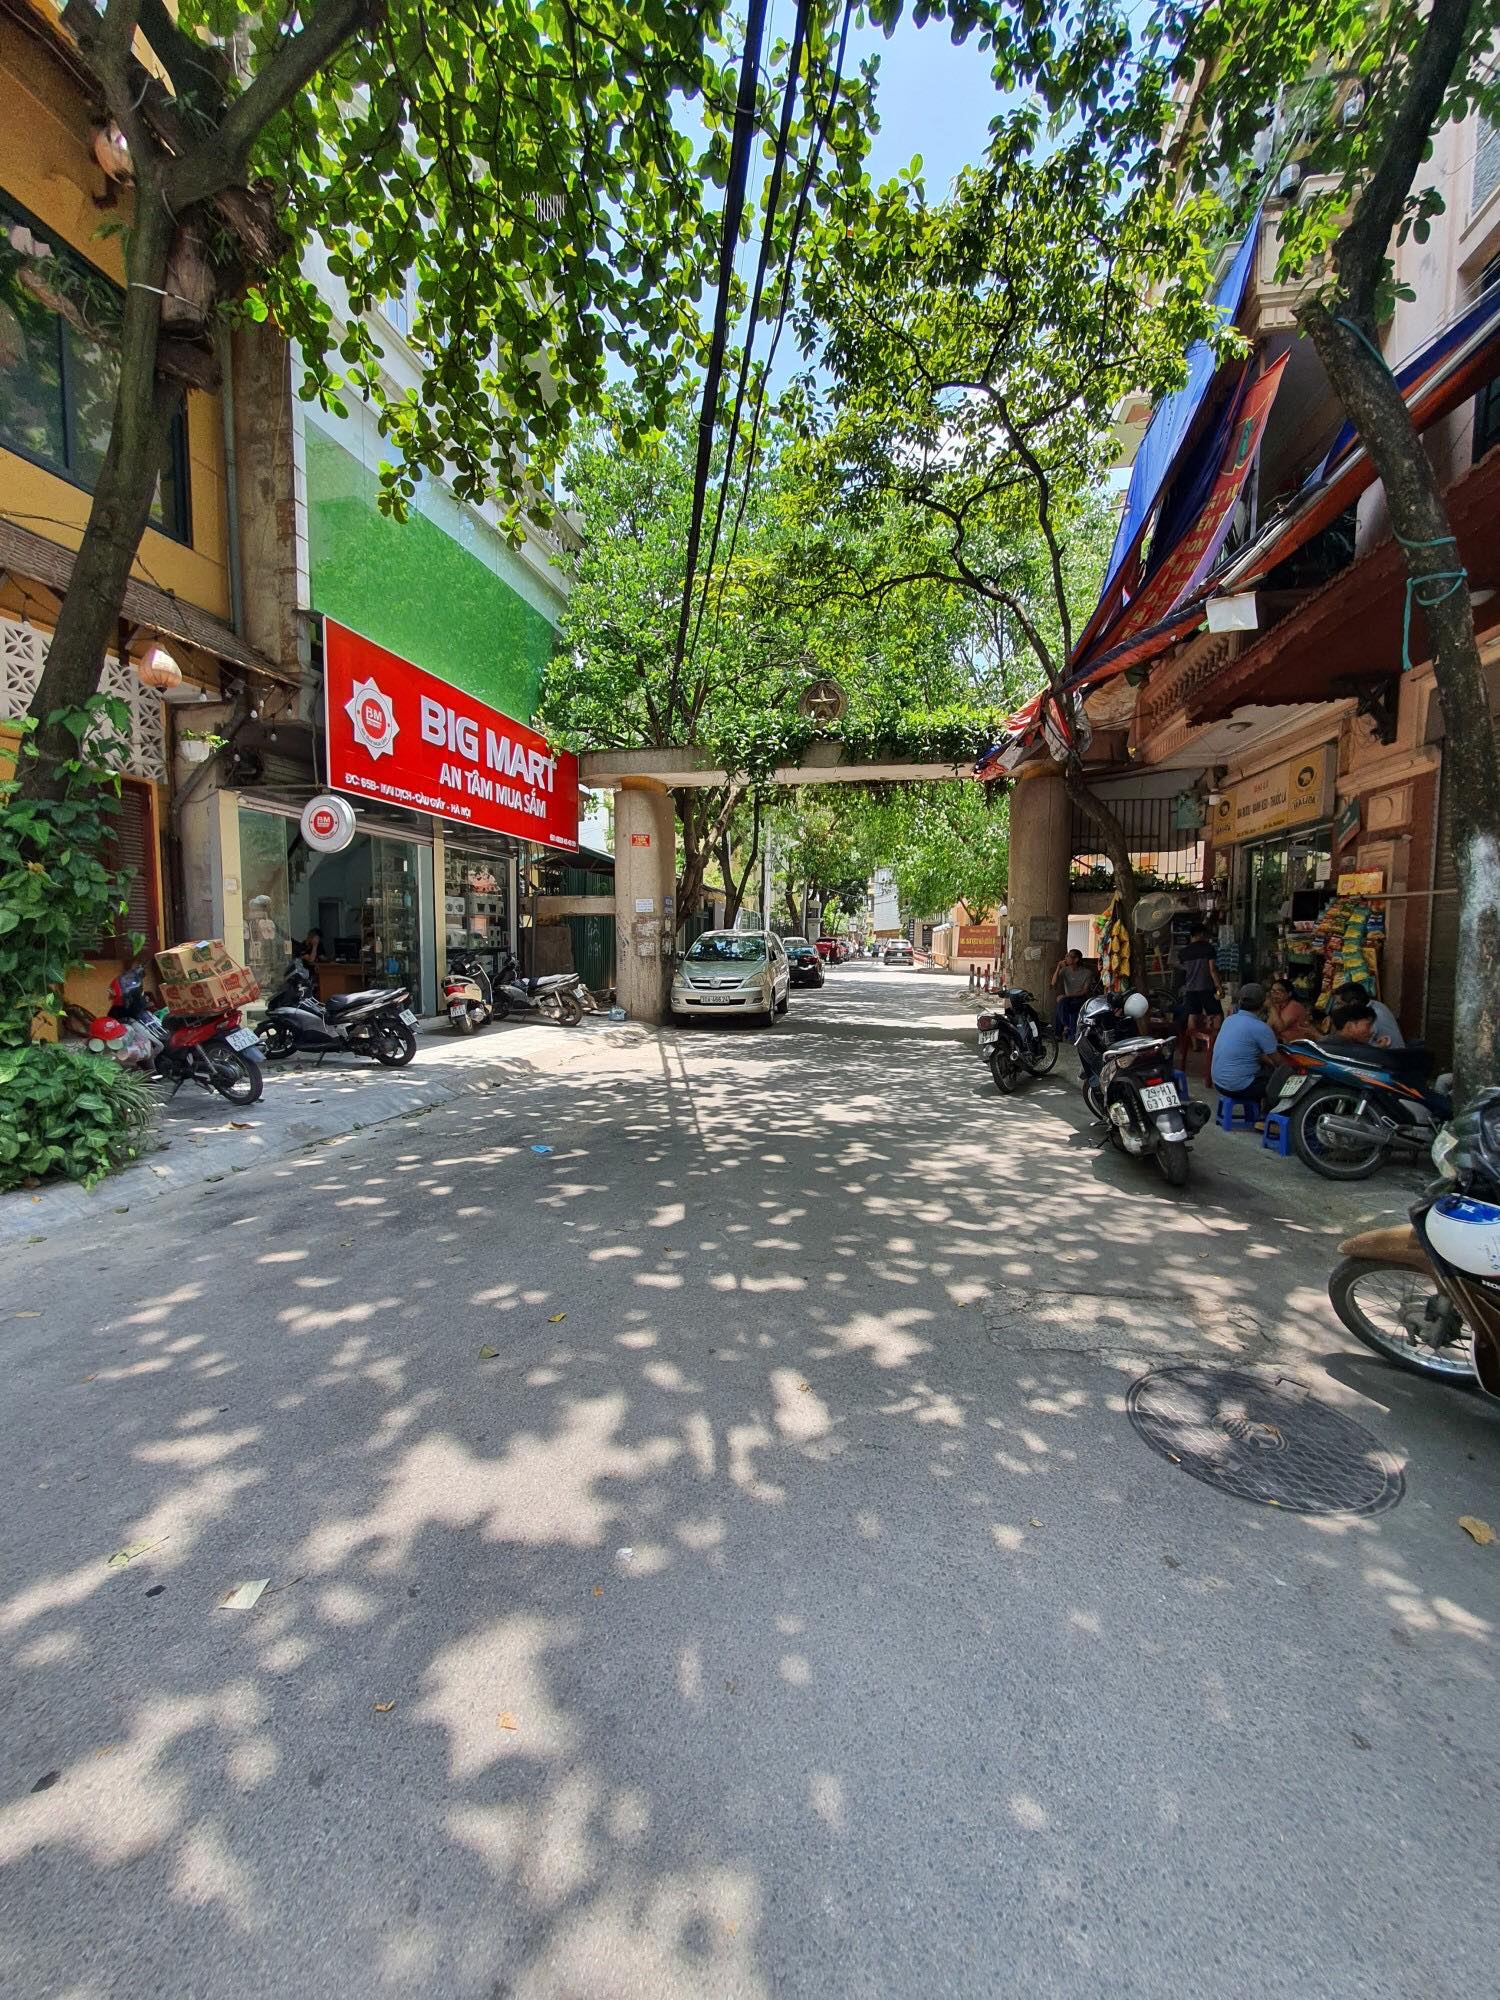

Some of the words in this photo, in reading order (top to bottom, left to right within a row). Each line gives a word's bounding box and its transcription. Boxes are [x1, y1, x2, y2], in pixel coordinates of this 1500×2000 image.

[366, 706, 382, 722] BM
[420, 694, 479, 762] BIG
[486, 727, 557, 793] MART
[439, 762, 462, 791] AN
[464, 769, 494, 801] TÂM
[495, 783, 523, 812] MUA
[523, 787, 546, 819] SẮM
